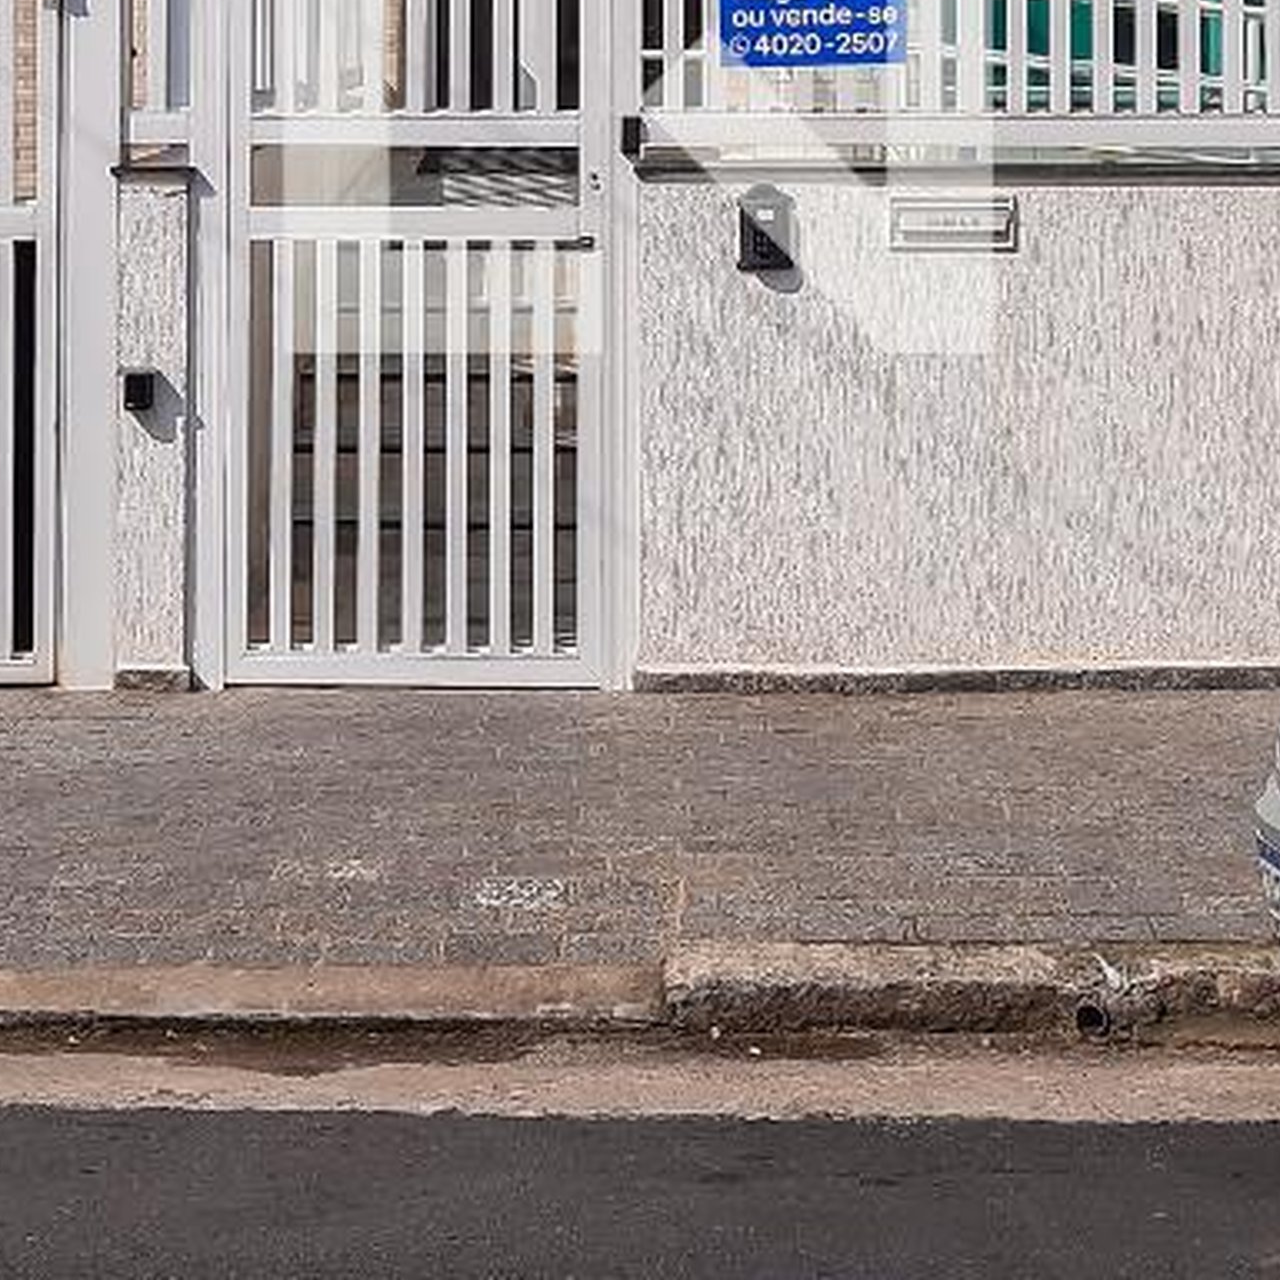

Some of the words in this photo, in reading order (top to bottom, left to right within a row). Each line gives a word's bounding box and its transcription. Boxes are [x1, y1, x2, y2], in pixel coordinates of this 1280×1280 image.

[732, 10, 765, 27] ou
[770, 3, 898, 25] vende-se
[753, 32, 898, 56] 4020-2507
